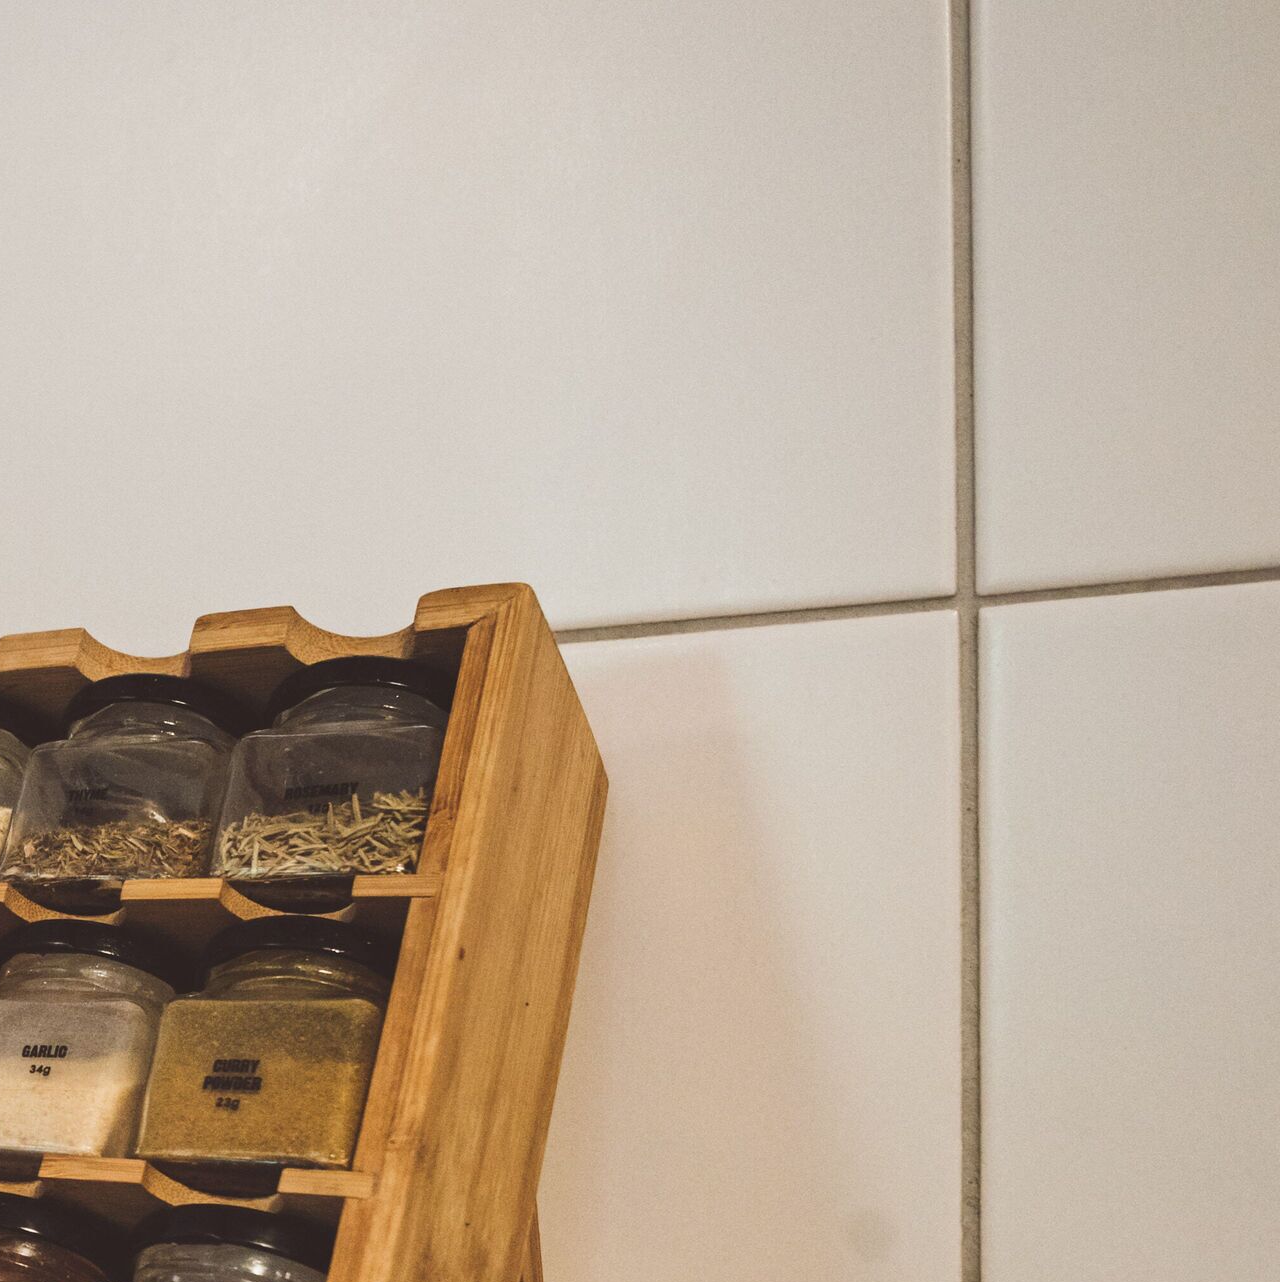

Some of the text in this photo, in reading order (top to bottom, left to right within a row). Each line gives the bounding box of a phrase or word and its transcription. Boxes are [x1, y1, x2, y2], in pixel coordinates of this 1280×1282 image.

[67, 787, 110, 802] THYME
[285, 781, 359, 800] ROSEMARY
[21, 1044, 68, 1058] GARLIC
[29, 1064, 51, 1077] 34g
[213, 1058, 261, 1073] CURRY
[202, 1075, 263, 1091] POWDER
